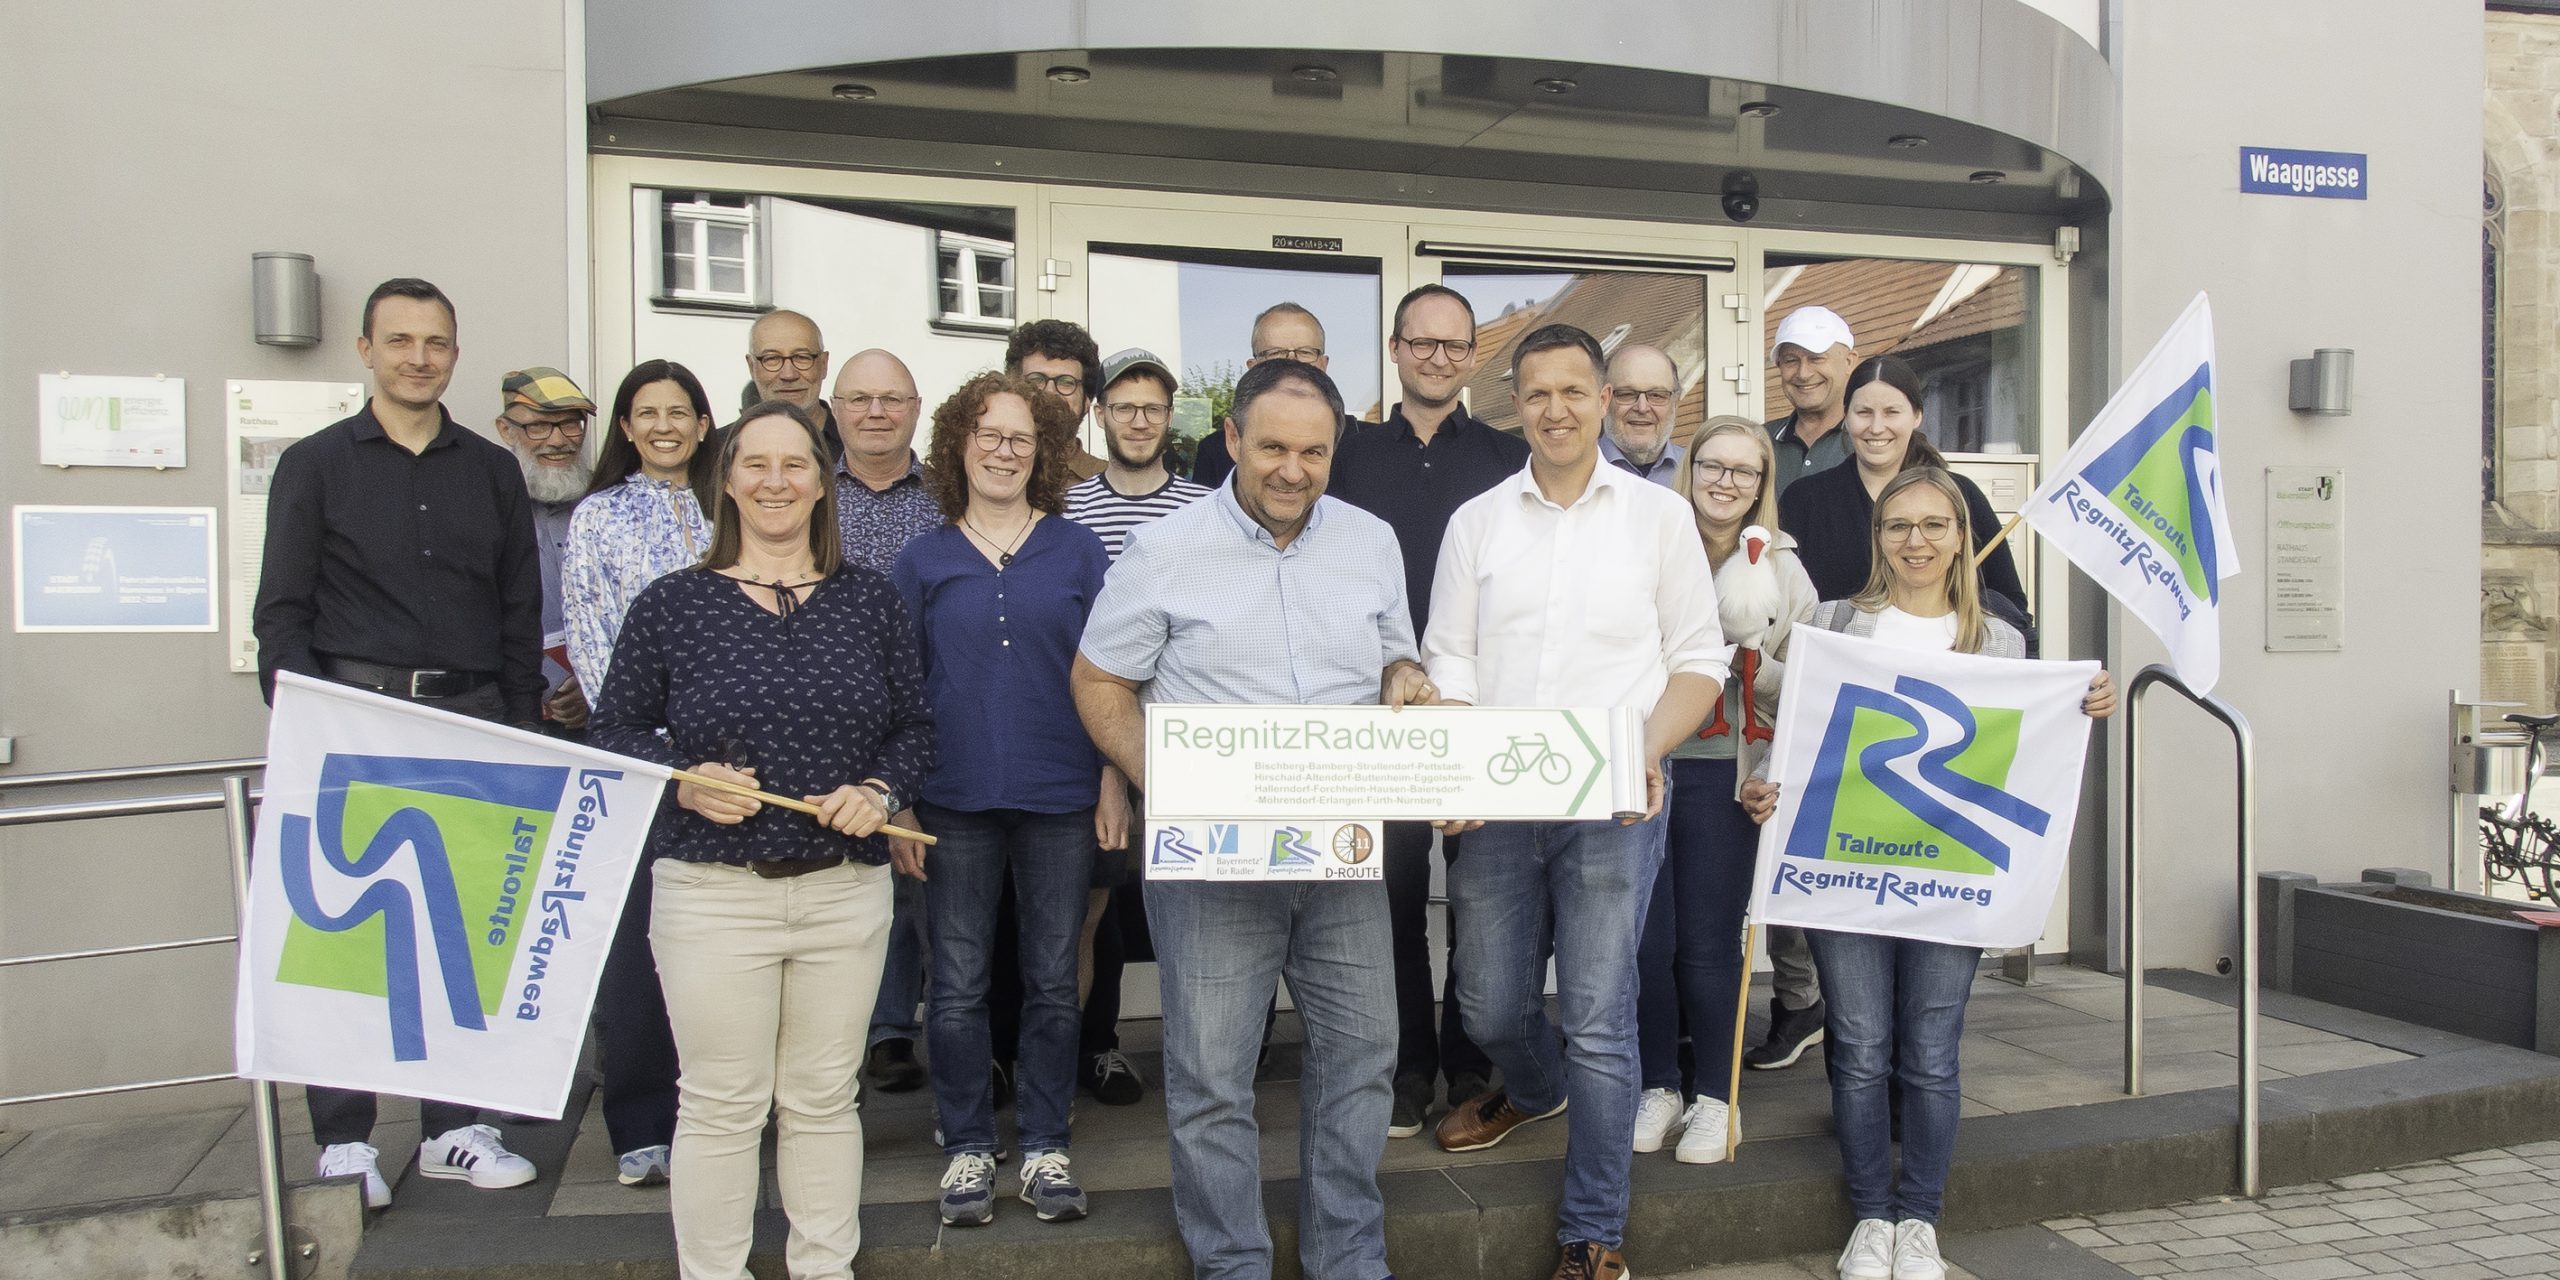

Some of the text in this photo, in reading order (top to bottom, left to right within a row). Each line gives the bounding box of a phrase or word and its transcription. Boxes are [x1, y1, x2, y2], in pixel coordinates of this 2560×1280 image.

[2249, 153, 2359, 193] Waaggasse
[2122, 482, 2189, 558] Talroute
[2048, 478, 2192, 623] RegnitzRadweg
[1163, 718, 1450, 757] RegnitzRadweg
[1355, 837, 1371, 849] 11
[1835, 831, 1940, 859] Talroute
[1216, 867, 1255, 875] für Radler
[1325, 867, 1381, 878] D-ROUTE
[1771, 861, 1993, 907] RegnitzRadweg
